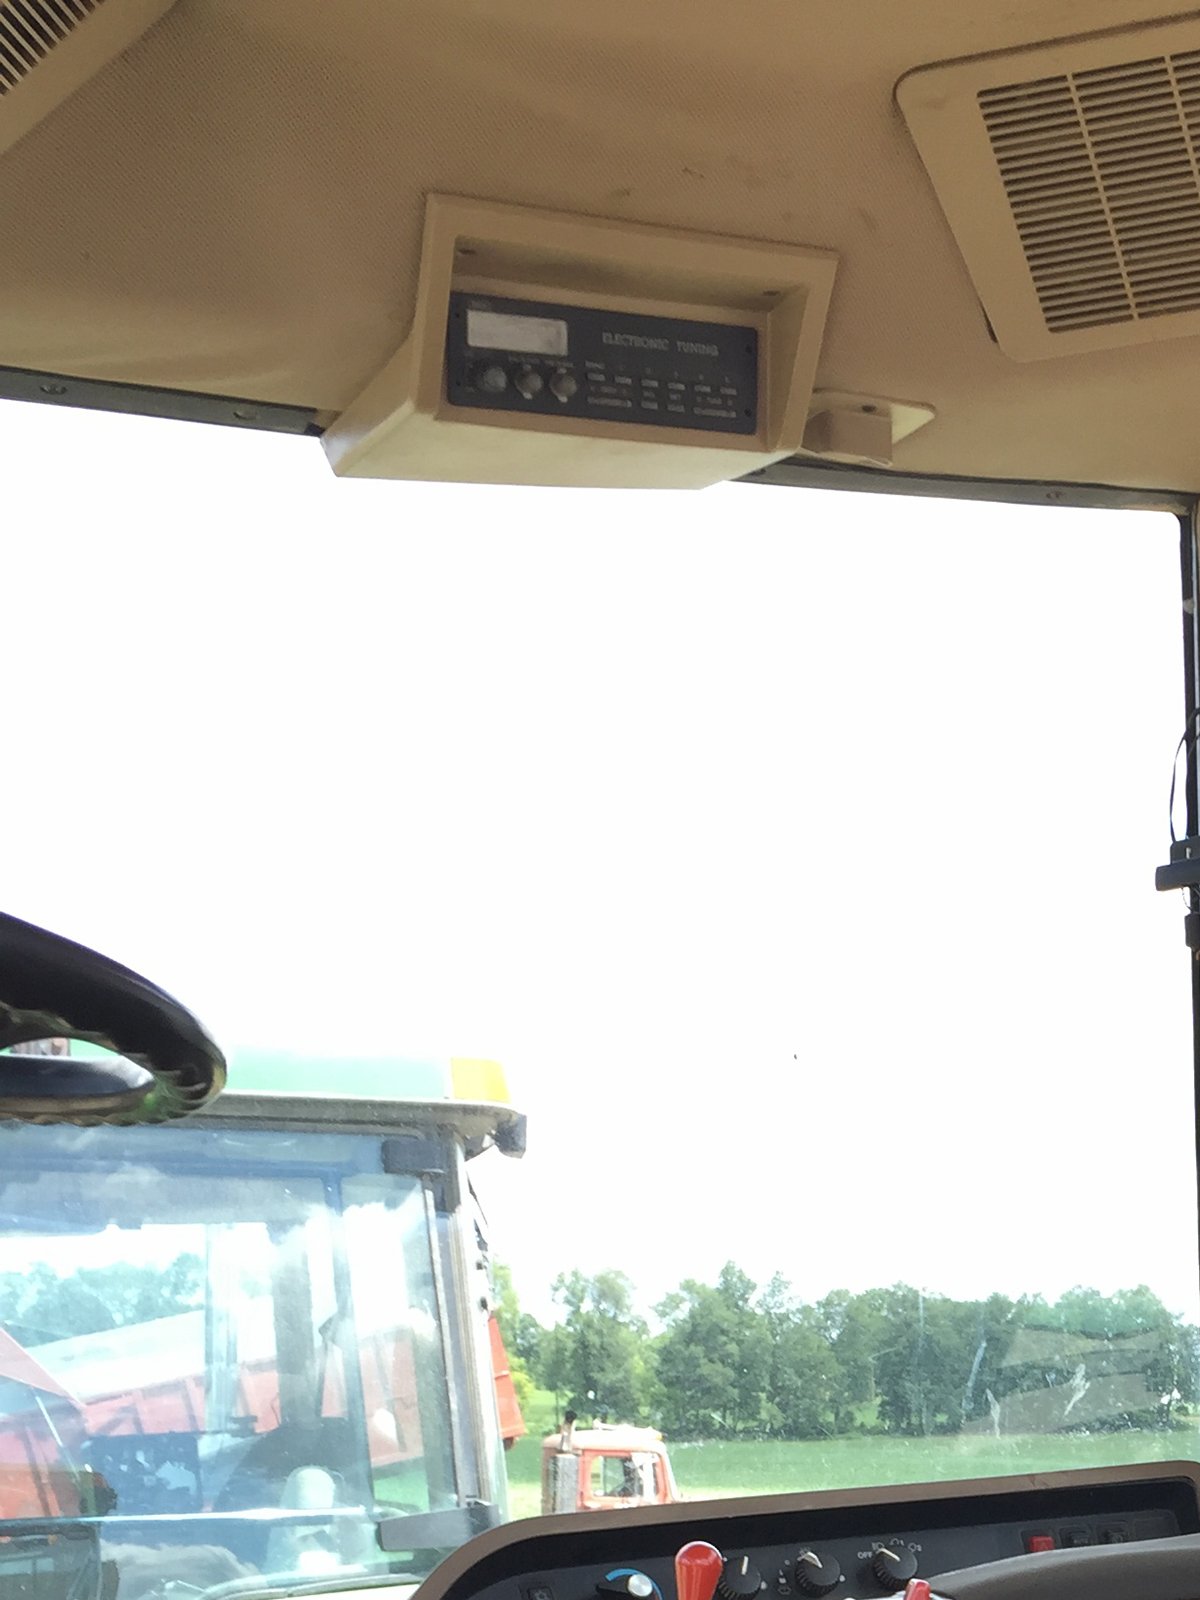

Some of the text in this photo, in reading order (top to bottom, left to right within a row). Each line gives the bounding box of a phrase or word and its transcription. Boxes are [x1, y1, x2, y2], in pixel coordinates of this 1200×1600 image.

[603, 331, 719, 357] ELECTRONIC TUNING
[857, 1551, 873, 1559] OFF
